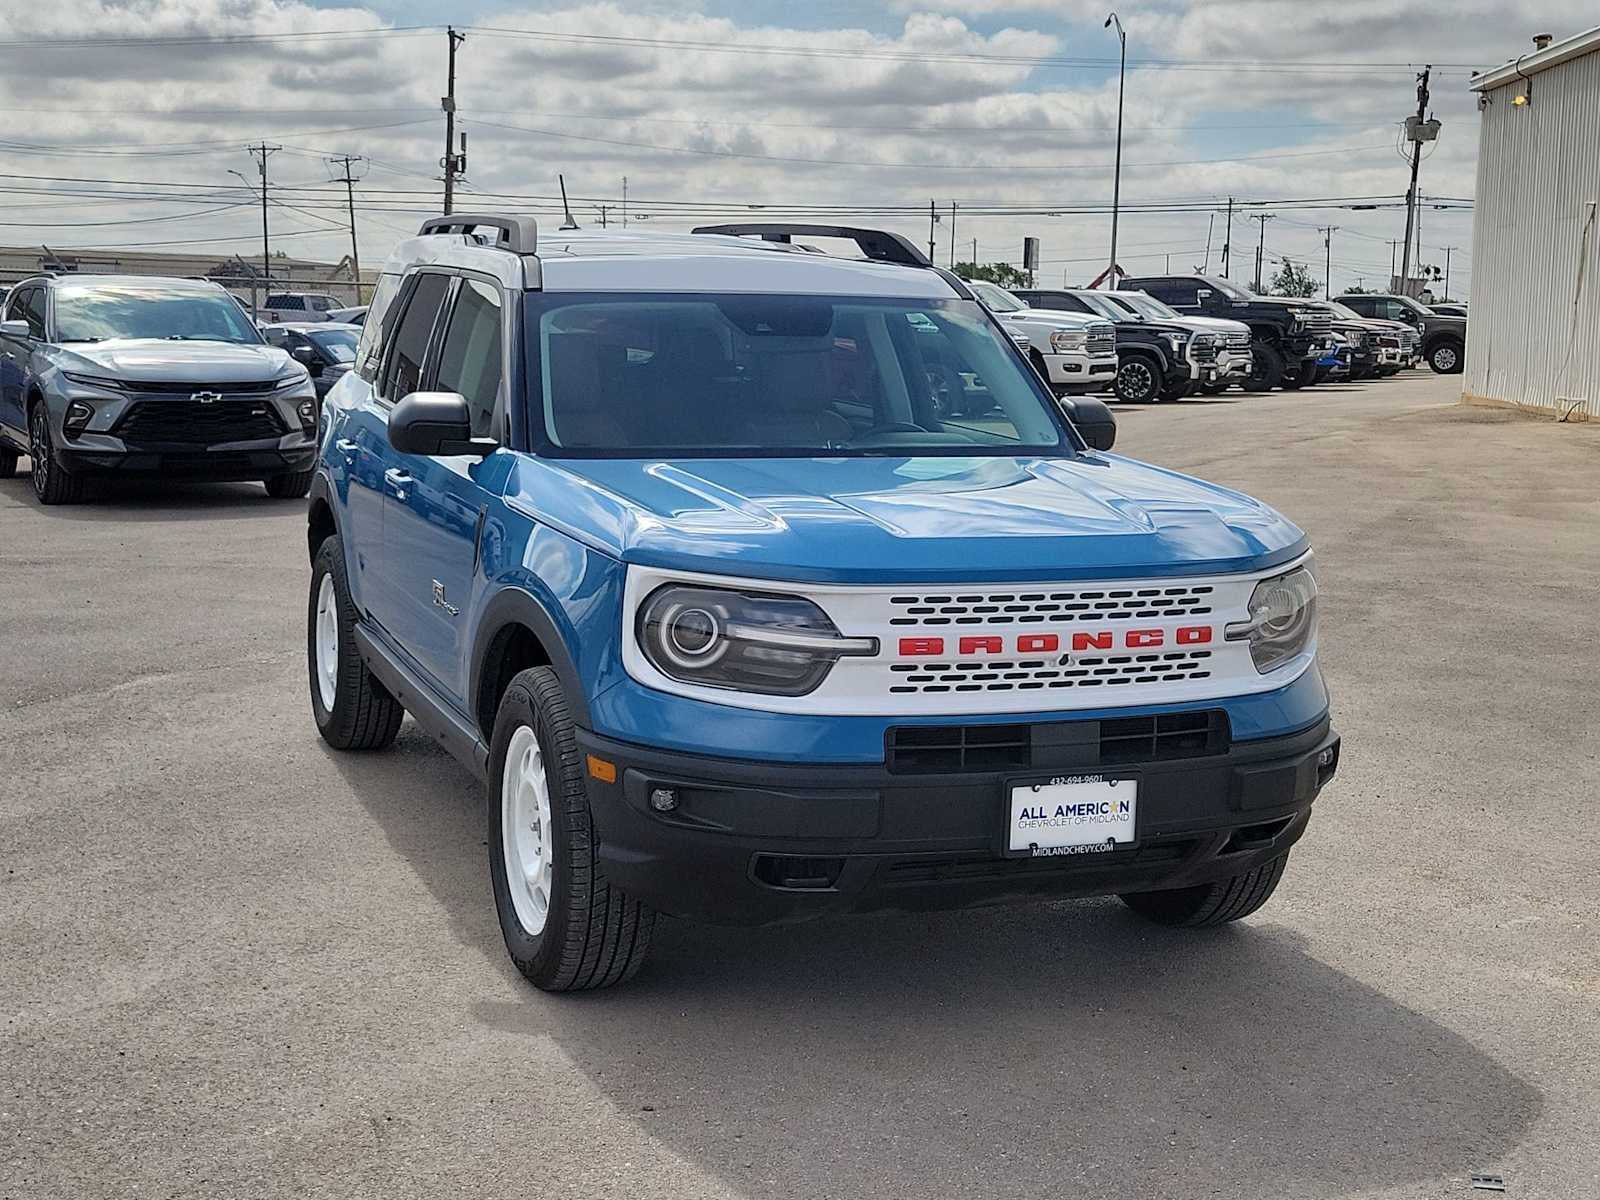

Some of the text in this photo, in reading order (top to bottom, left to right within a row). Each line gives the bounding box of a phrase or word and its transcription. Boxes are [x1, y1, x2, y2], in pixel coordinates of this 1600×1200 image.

[899, 626, 1212, 656] BRONCO
[1019, 806, 1047, 820] ALL
[1018, 813, 1130, 829] CHEVROLET OF MIDLAND
[1032, 843, 1114, 857] MIDLANDCHEVY.COM
